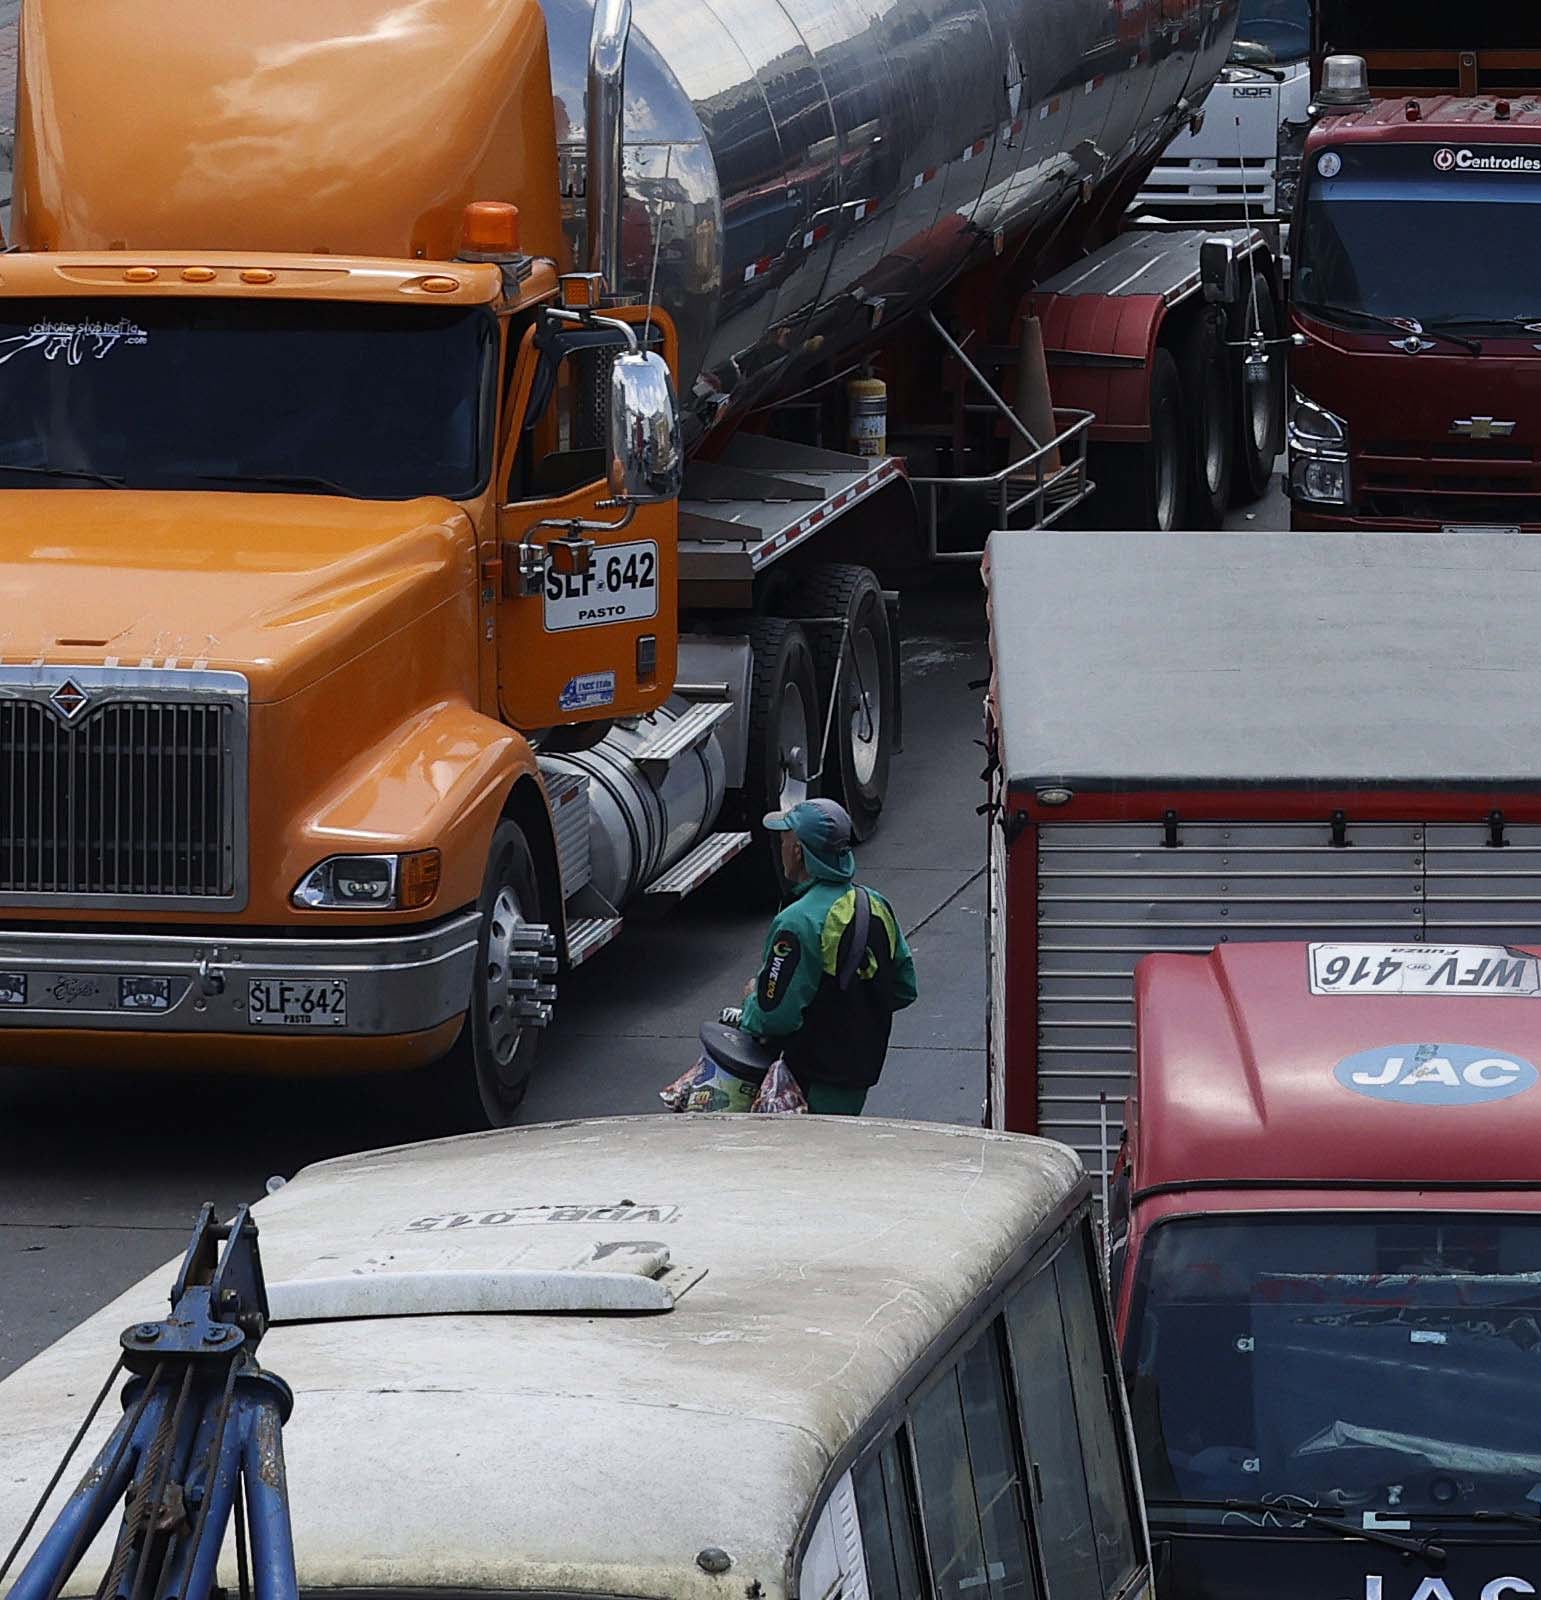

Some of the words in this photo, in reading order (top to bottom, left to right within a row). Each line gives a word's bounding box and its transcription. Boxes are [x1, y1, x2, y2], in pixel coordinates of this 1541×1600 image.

[1232, 87, 1272, 97] NQR
[606, 551, 656, 593] 642
[577, 604, 626, 621] PASTO
[1391, 947, 1461, 956] Funza
[1320, 955, 1403, 987] 416
[1426, 957, 1528, 988] WFV
[283, 1014, 312, 1024] PASTO
[1351, 1057, 1521, 1088] JAC
